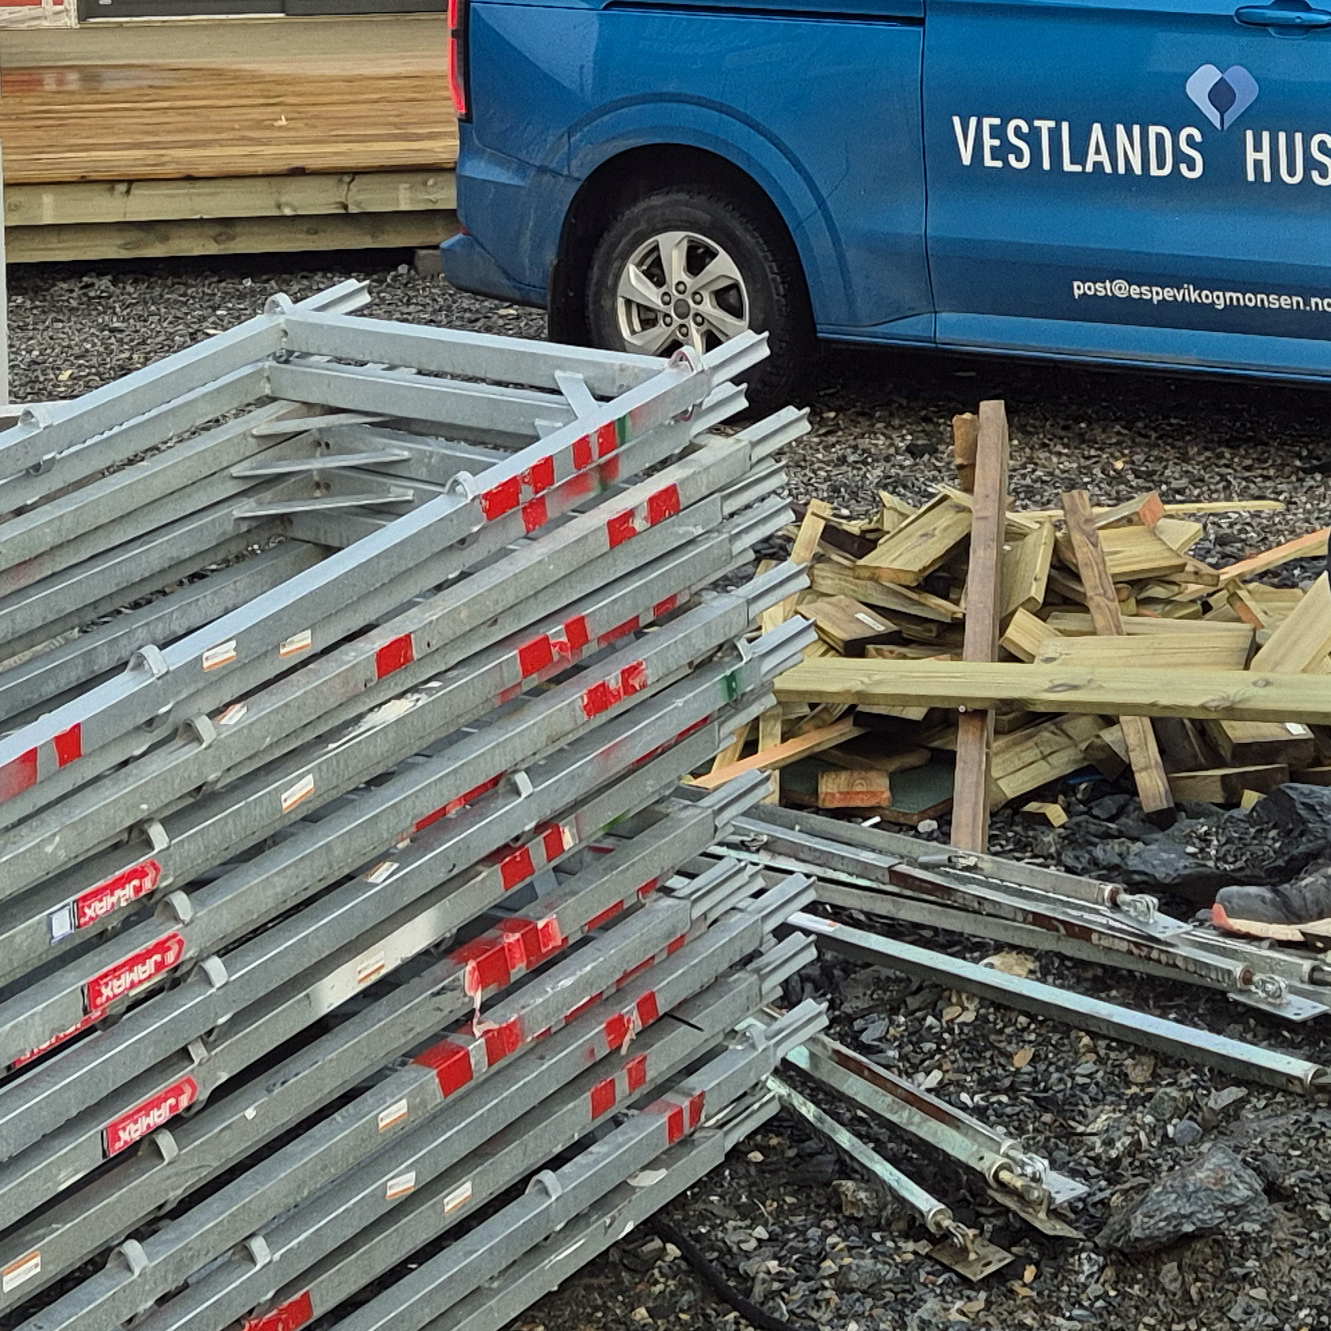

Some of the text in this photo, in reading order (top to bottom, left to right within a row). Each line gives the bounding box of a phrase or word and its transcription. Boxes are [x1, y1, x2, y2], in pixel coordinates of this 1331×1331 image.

[952, 115, 1204, 180] VESTLANDS
[100, 952, 162, 999] JAMAX
[117, 1096, 179, 1148] JAMAX
